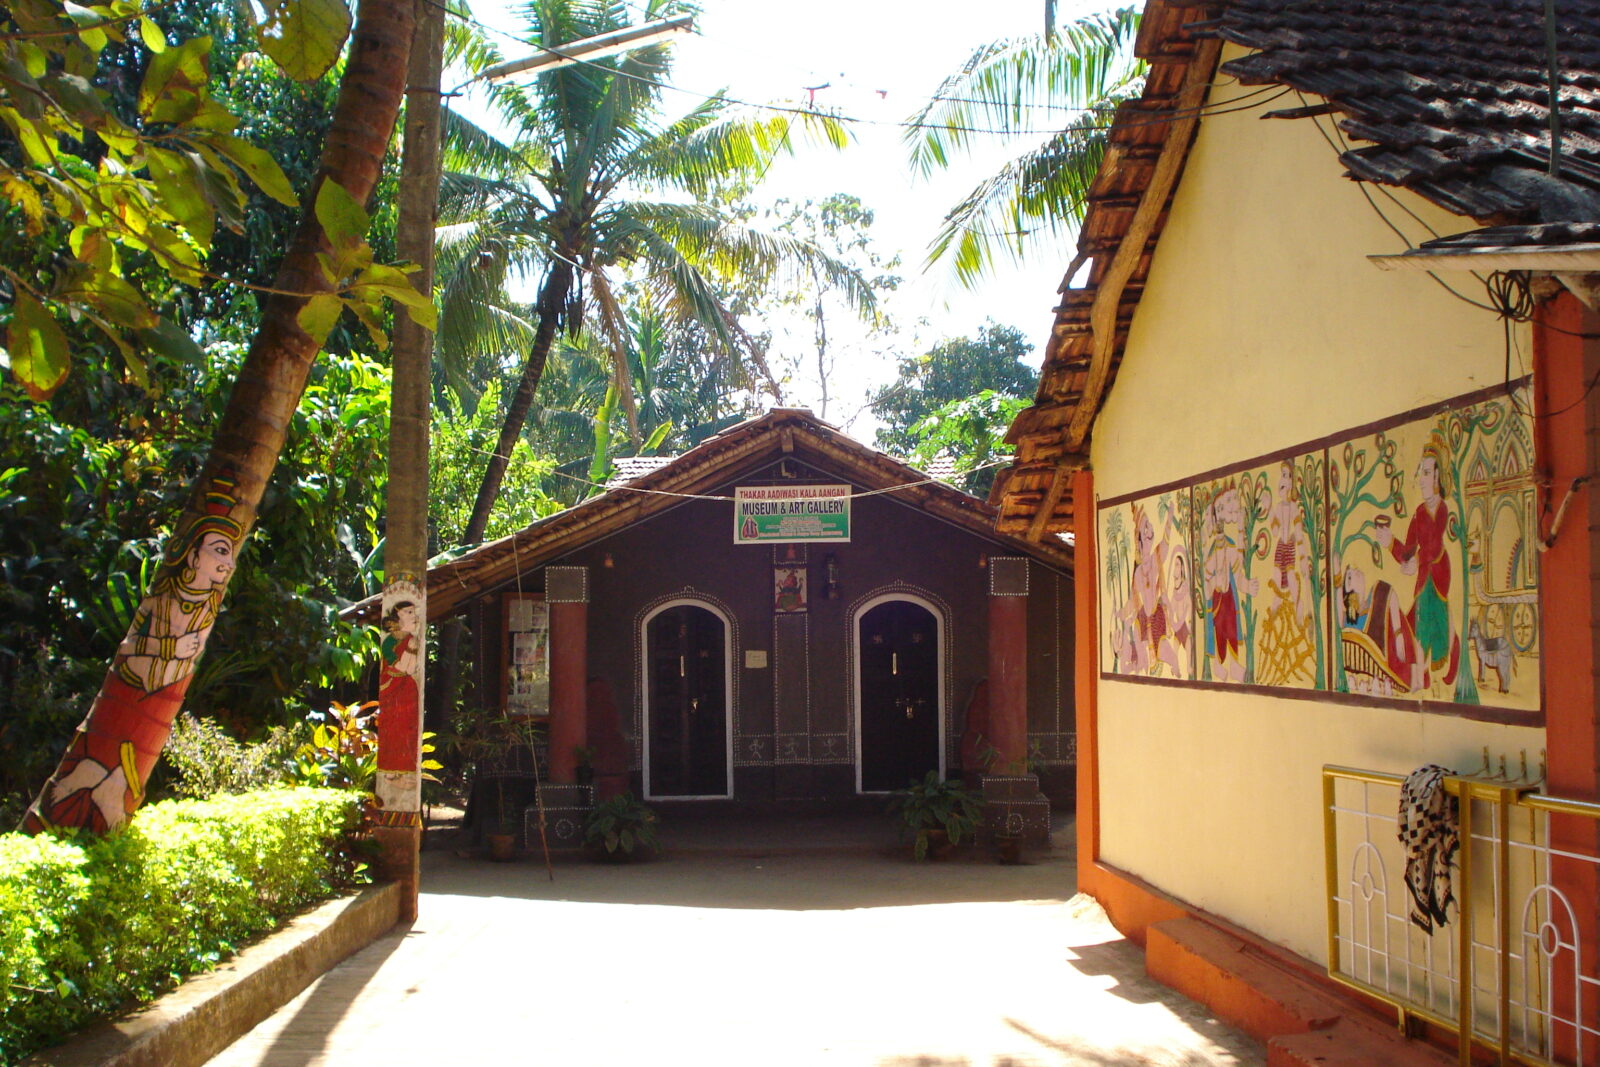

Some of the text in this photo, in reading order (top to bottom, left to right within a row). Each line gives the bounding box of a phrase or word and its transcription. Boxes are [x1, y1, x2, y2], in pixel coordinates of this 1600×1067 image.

[740, 490, 766, 499] THAKAR
[800, 489, 816, 497] KALA
[743, 501, 844, 515] MUSEUM & ART GALLERY
